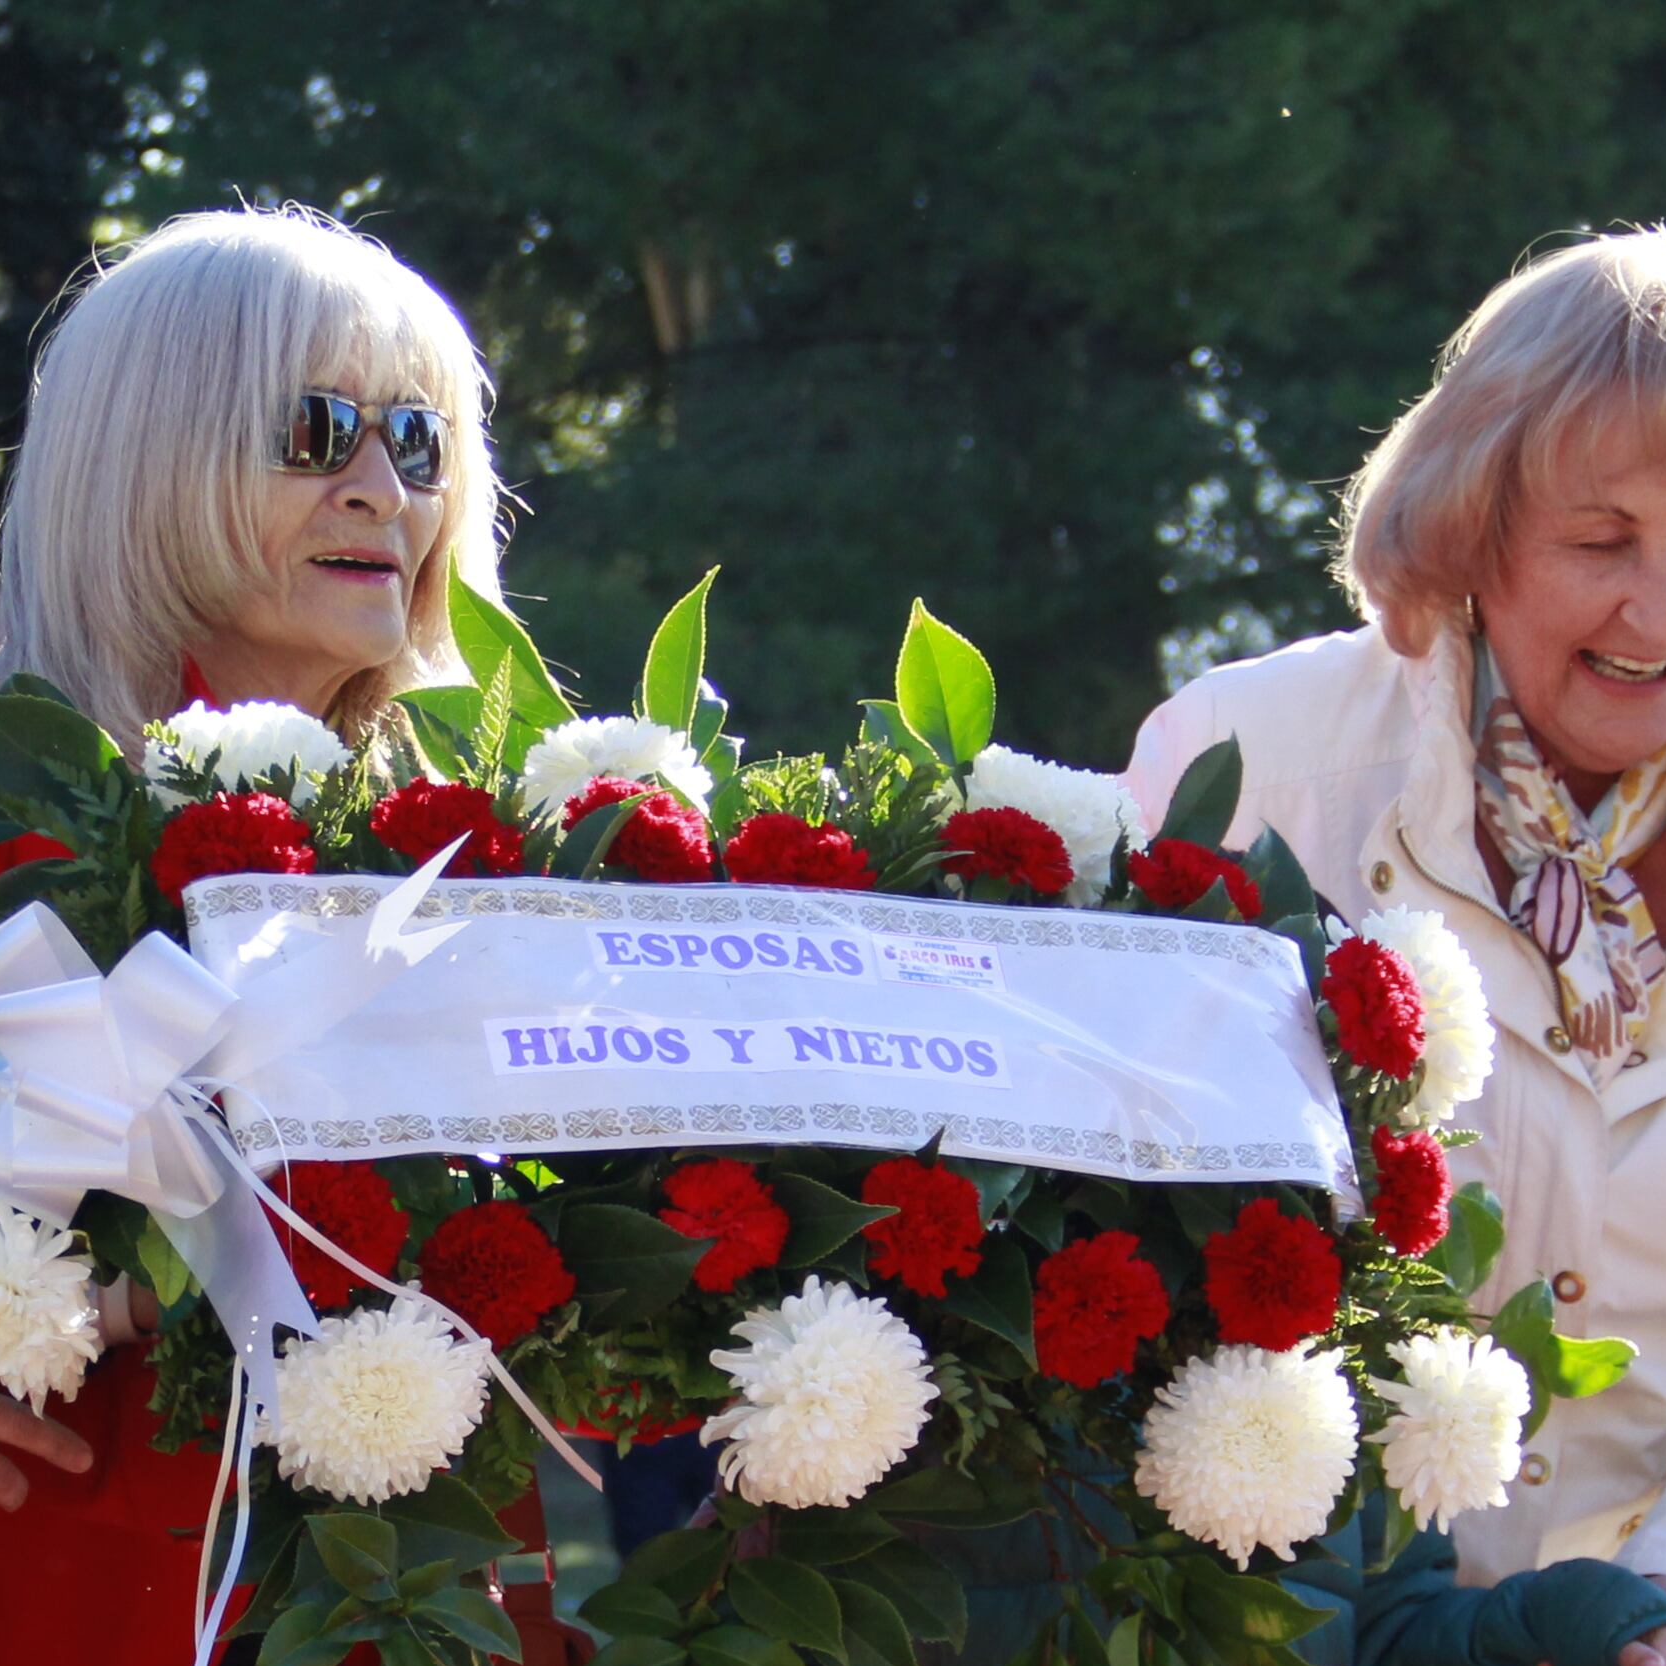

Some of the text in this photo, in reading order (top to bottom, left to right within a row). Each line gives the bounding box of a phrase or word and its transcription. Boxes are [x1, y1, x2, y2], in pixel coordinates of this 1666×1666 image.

[596, 932, 864, 976] ESPOSAS
[900, 949, 976, 968] ARCO IRIS
[502, 1025, 999, 1077] HIJOS Y NIETOS
